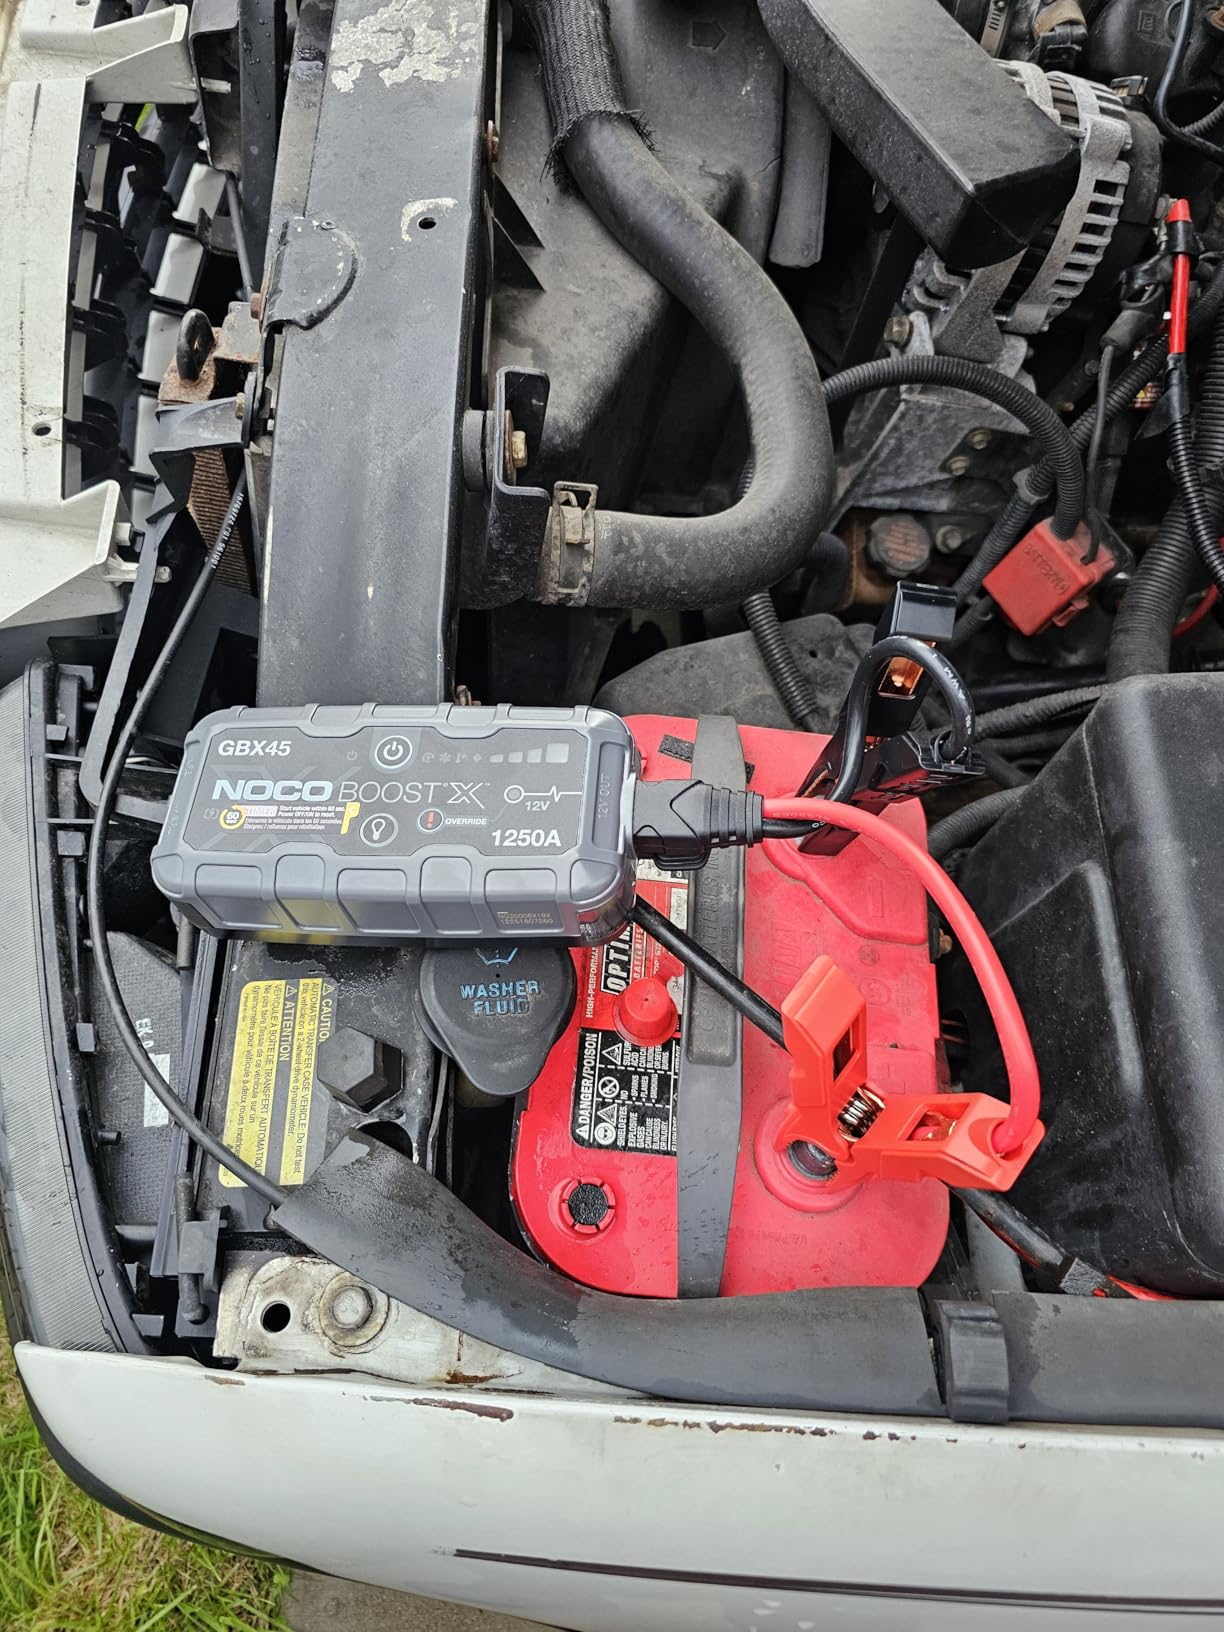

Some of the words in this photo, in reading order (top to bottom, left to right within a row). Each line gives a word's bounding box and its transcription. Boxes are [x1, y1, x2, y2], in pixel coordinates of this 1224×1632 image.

[218, 740, 291, 757] GBX45
[212, 780, 333, 801] NOCO
[227, 811, 239, 820] 60
[525, 801, 549, 812] 12V
[445, 817, 487, 826] OVERRIDE
[492, 829, 561, 847] 1250A
[702, 876, 719, 954] ATTERIES,
[634, 928, 644, 978] BATTERIES
[460, 980, 540, 999] WASHER
[308, 982, 319, 1025] AUTOMATIC
[473, 998, 530, 1017] FLUID
[260, 1010, 268, 1025] faire
[246, 1031, 254, 1047] pour
[279, 1001, 296, 1061] ATTENTION
[257, 1048, 263, 1057] de
[304, 1028, 316, 1069] TRANSFER
[255, 1060, 262, 1068] ce
[265, 1055, 273, 1065] DE
[631, 1052, 639, 1067] ACID
[655, 1061, 662, 1070] OR
[302, 1069, 312, 1093] CASE
[578, 1033, 598, 1124] DANGER/POISON
[631, 1075, 639, 1096] SPARKS
[641, 1075, 649, 1097] FLAMES
[650, 1073, 658, 1099] SMOKING
[240, 1086, 248, 1104] deux
[260, 1068, 273, 1114] TRANSFERT
[620, 1090, 628, 1100] NO
[237, 1106, 245, 1125] roues
[249, 1113, 255, 1123] un
[288, 1085, 300, 1137] dynamometer.
[619, 1105, 628, 1123] EYES.
[297, 1130, 305, 1142] Do
[617, 1123, 627, 1146] SHIELD
[628, 1112, 638, 1148] EXPLOSIVE
[645, 1117, 654, 1136] CAUSE
[652, 1118, 661, 1149] BLINDNESS
[660, 1120, 669, 1141] INJURY.
[637, 1126, 645, 1148] GASES
[660, 1141, 668, 1150] OR
[295, 1143, 303, 1155] not
[293, 1156, 301, 1174] test
